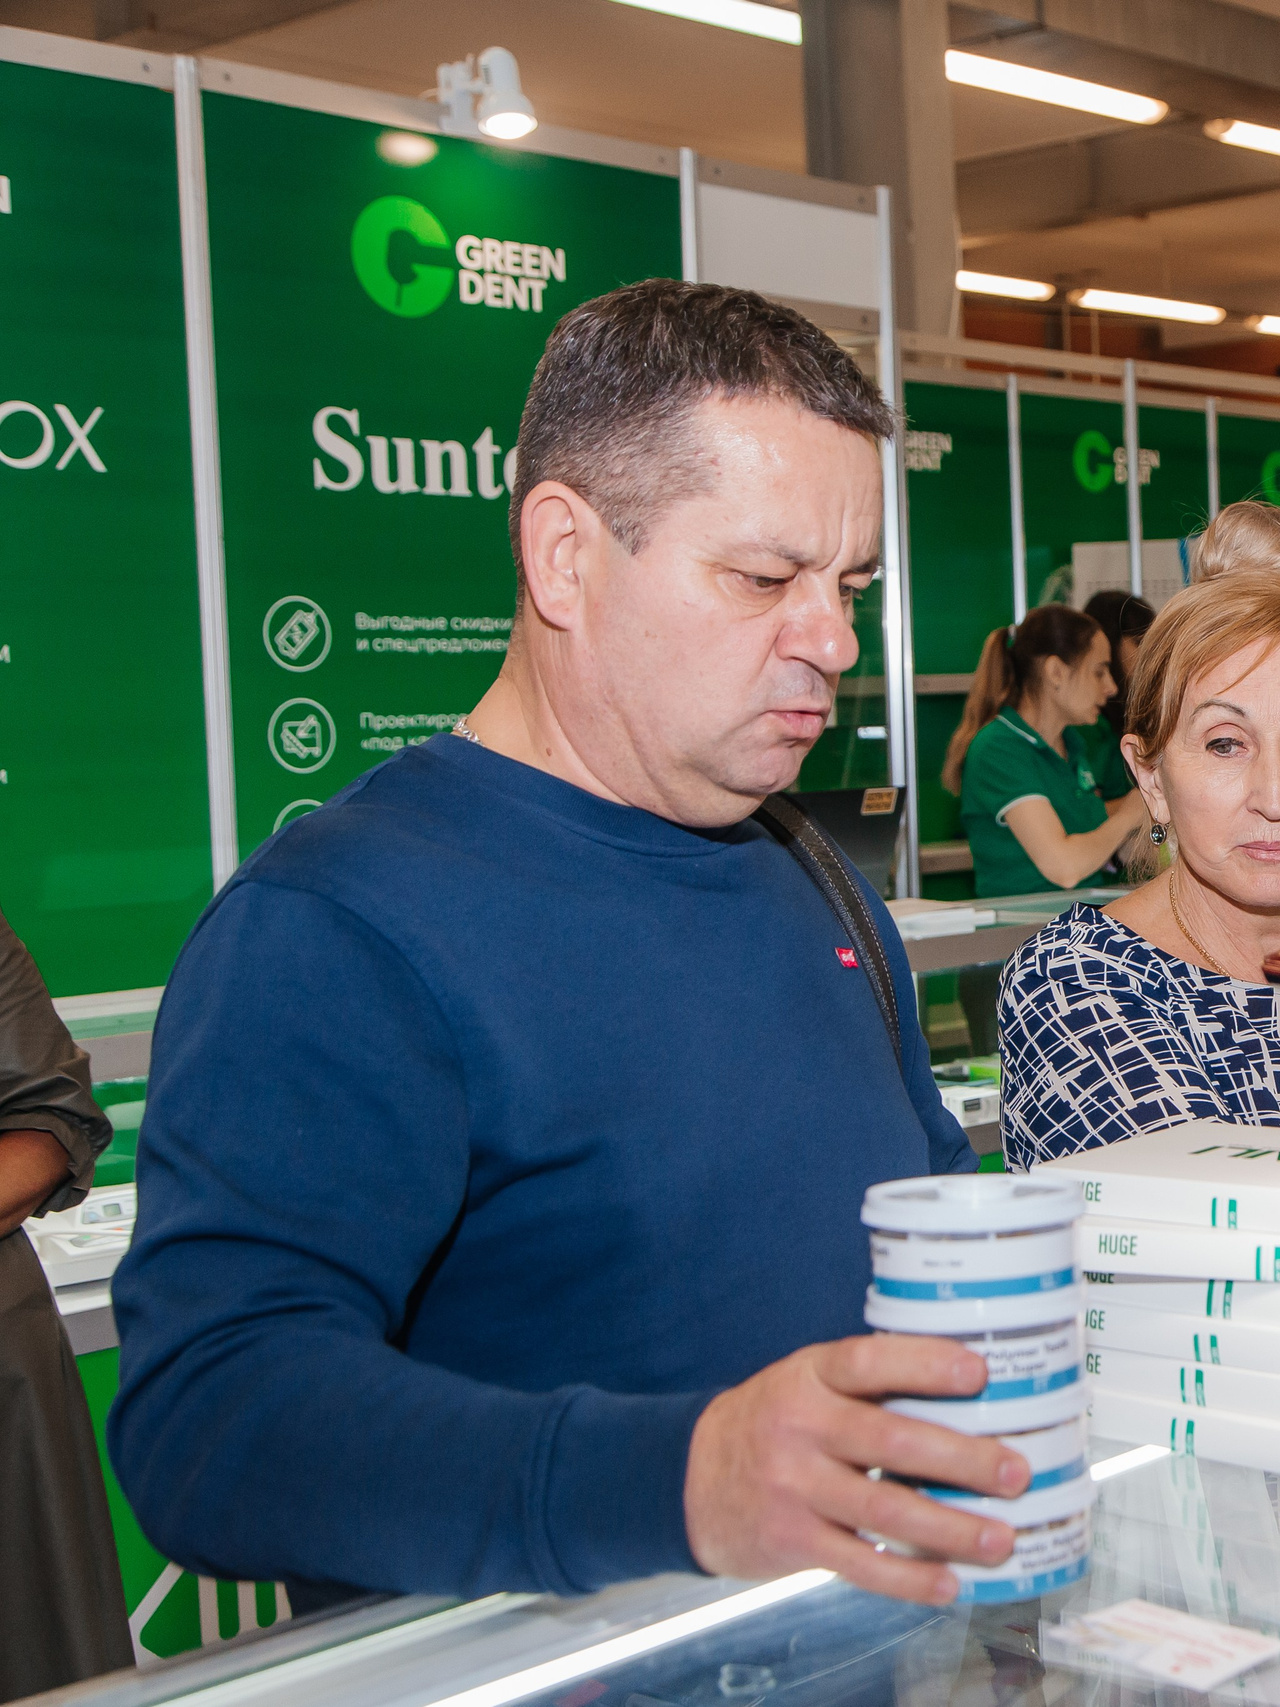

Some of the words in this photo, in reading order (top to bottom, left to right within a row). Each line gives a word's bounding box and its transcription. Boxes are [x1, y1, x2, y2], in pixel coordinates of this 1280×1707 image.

[455, 234, 567, 283] GREEN
[458, 268, 548, 314] DENT
[354, 612, 448, 632] Выгодные
[355, 637, 370, 650] и
[371, 637, 512, 654] спецпредложе
[1082, 1181, 1102, 1202] GE
[1098, 1233, 1138, 1256] HUGE
